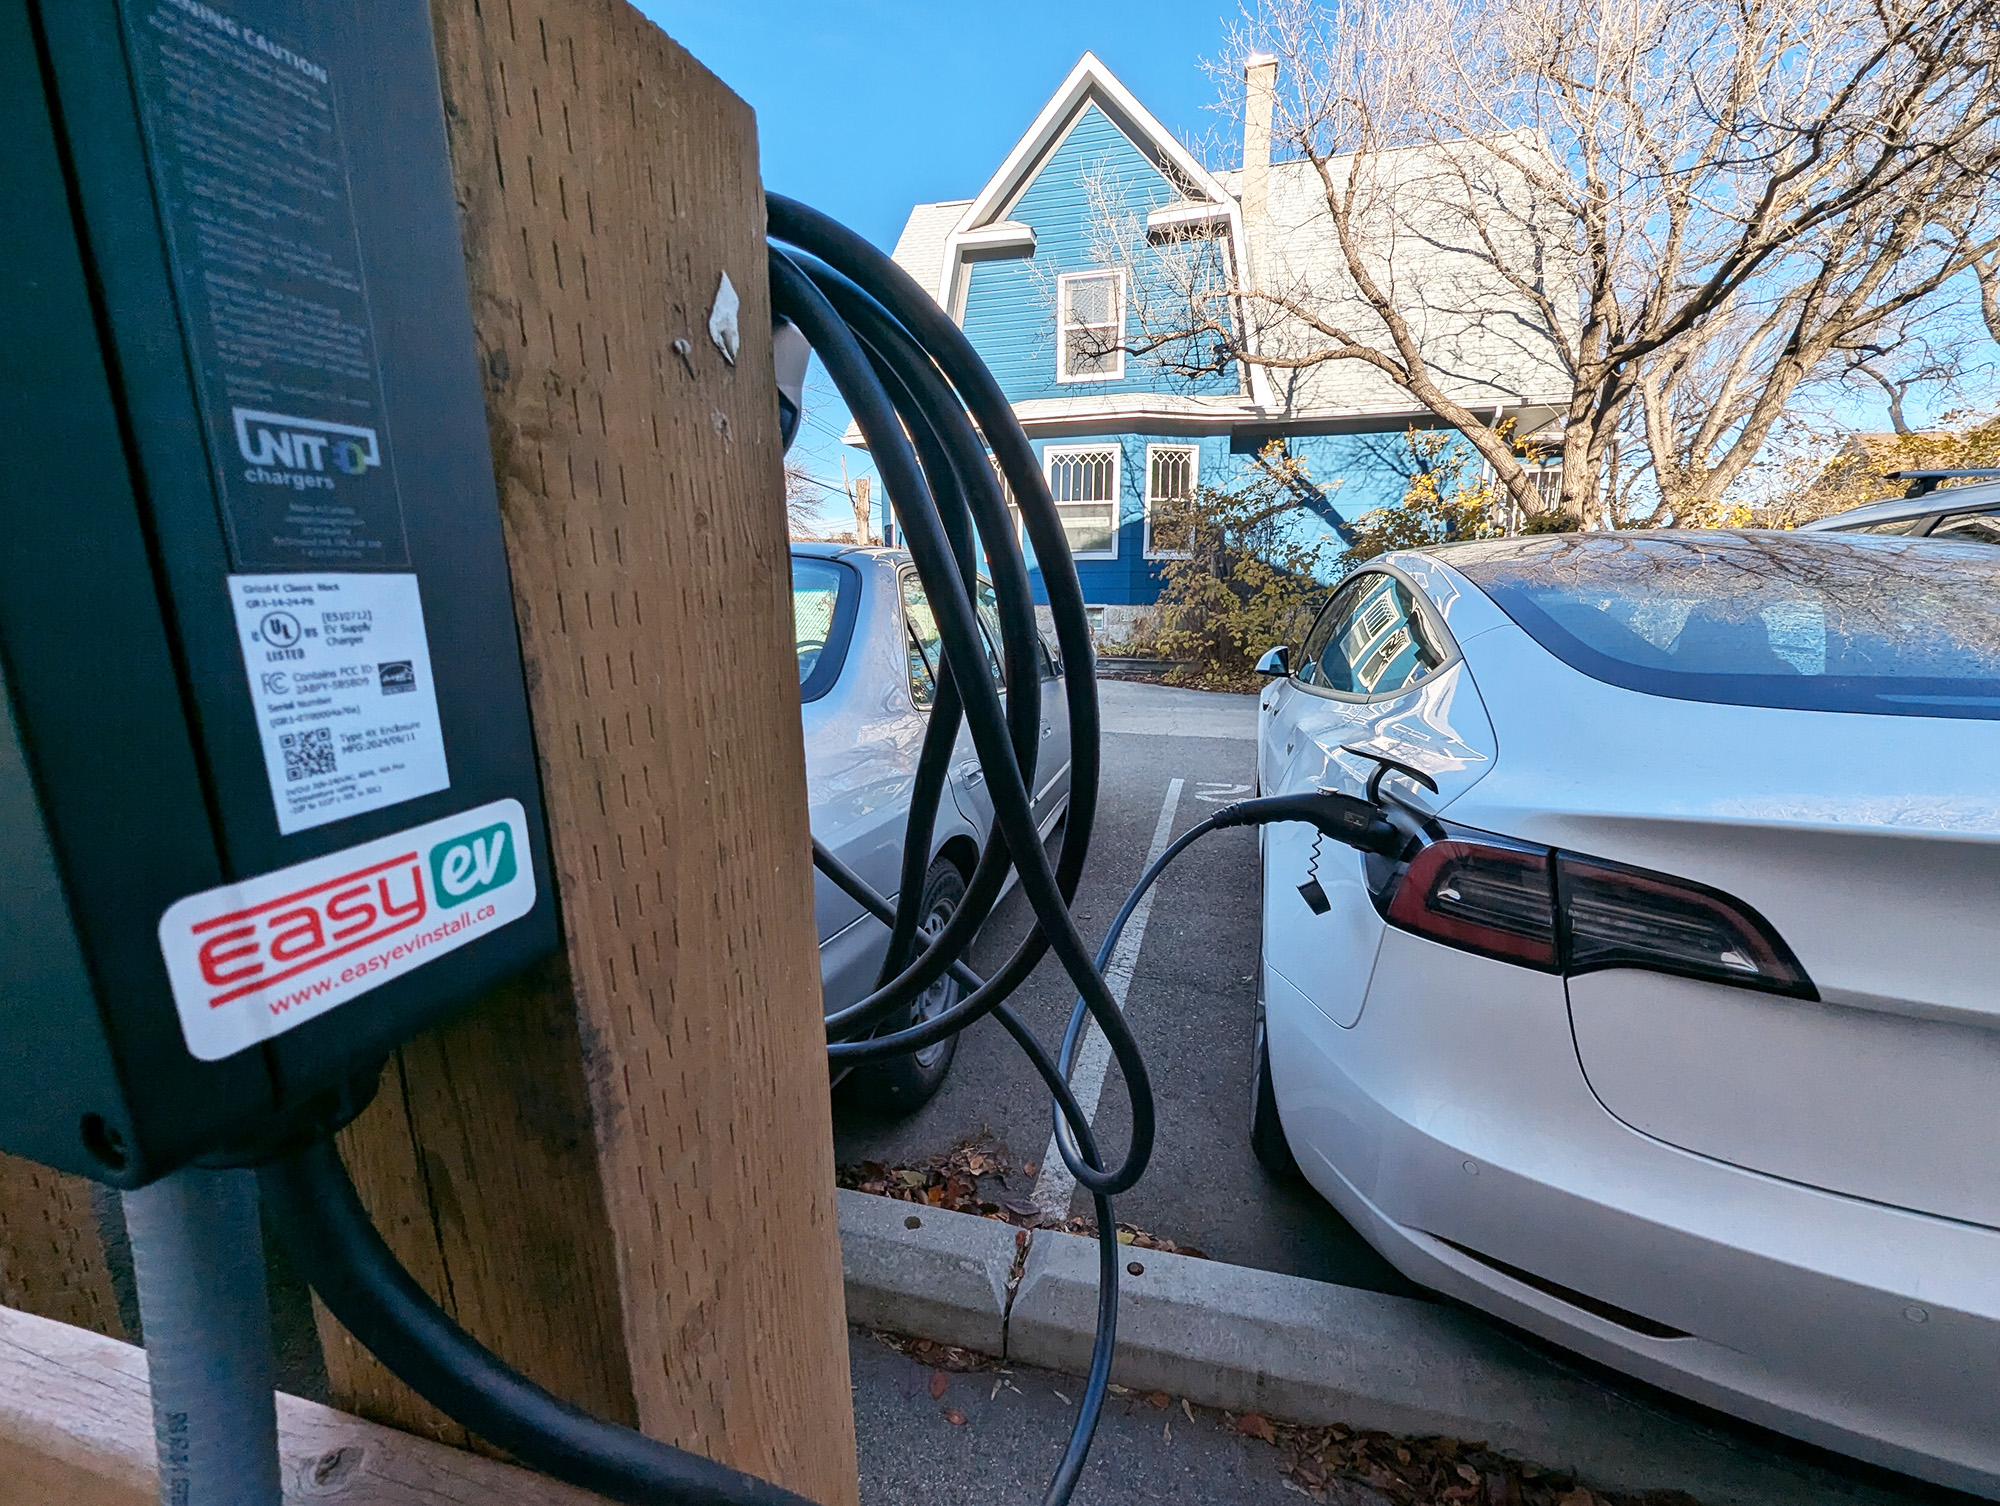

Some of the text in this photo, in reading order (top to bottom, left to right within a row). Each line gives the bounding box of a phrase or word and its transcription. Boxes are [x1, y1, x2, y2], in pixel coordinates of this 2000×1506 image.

[243, 28, 327, 84] CAUTION
[244, 467, 335, 490] chargers
[269, 619, 292, 639] UL
[326, 637, 364, 646] Charger
[266, 647, 305, 662] LISTED
[292, 670, 337, 682] Contains
[340, 733, 363, 742] Type
[380, 722, 420, 736] Enclosure
[268, 904, 497, 1016] www.easyevinstall.ca
